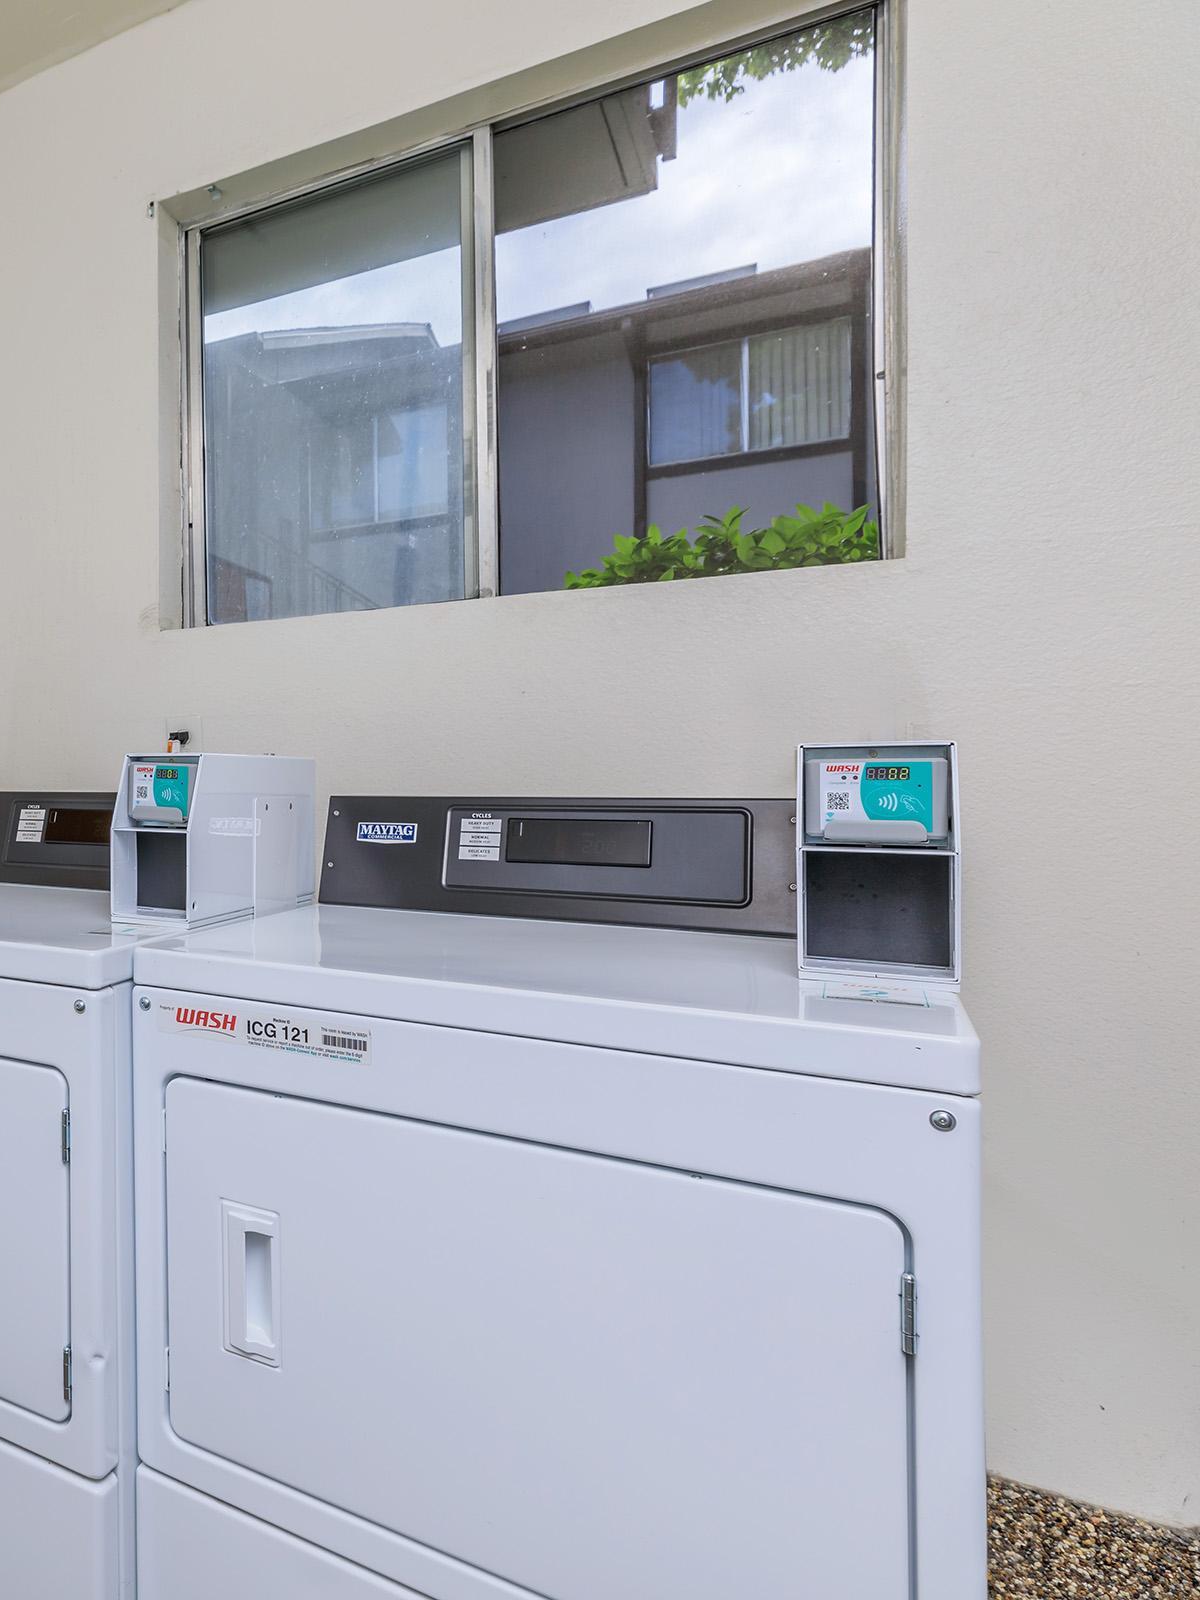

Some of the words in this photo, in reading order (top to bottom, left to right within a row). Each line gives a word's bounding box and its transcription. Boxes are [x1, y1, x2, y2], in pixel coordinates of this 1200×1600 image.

[826, 765, 860, 773] WASH
[360, 824, 413, 836] MAYTAG
[175, 1007, 237, 1031] WASH
[247, 1020, 277, 1038] ICG
[282, 1025, 308, 1043] 121
